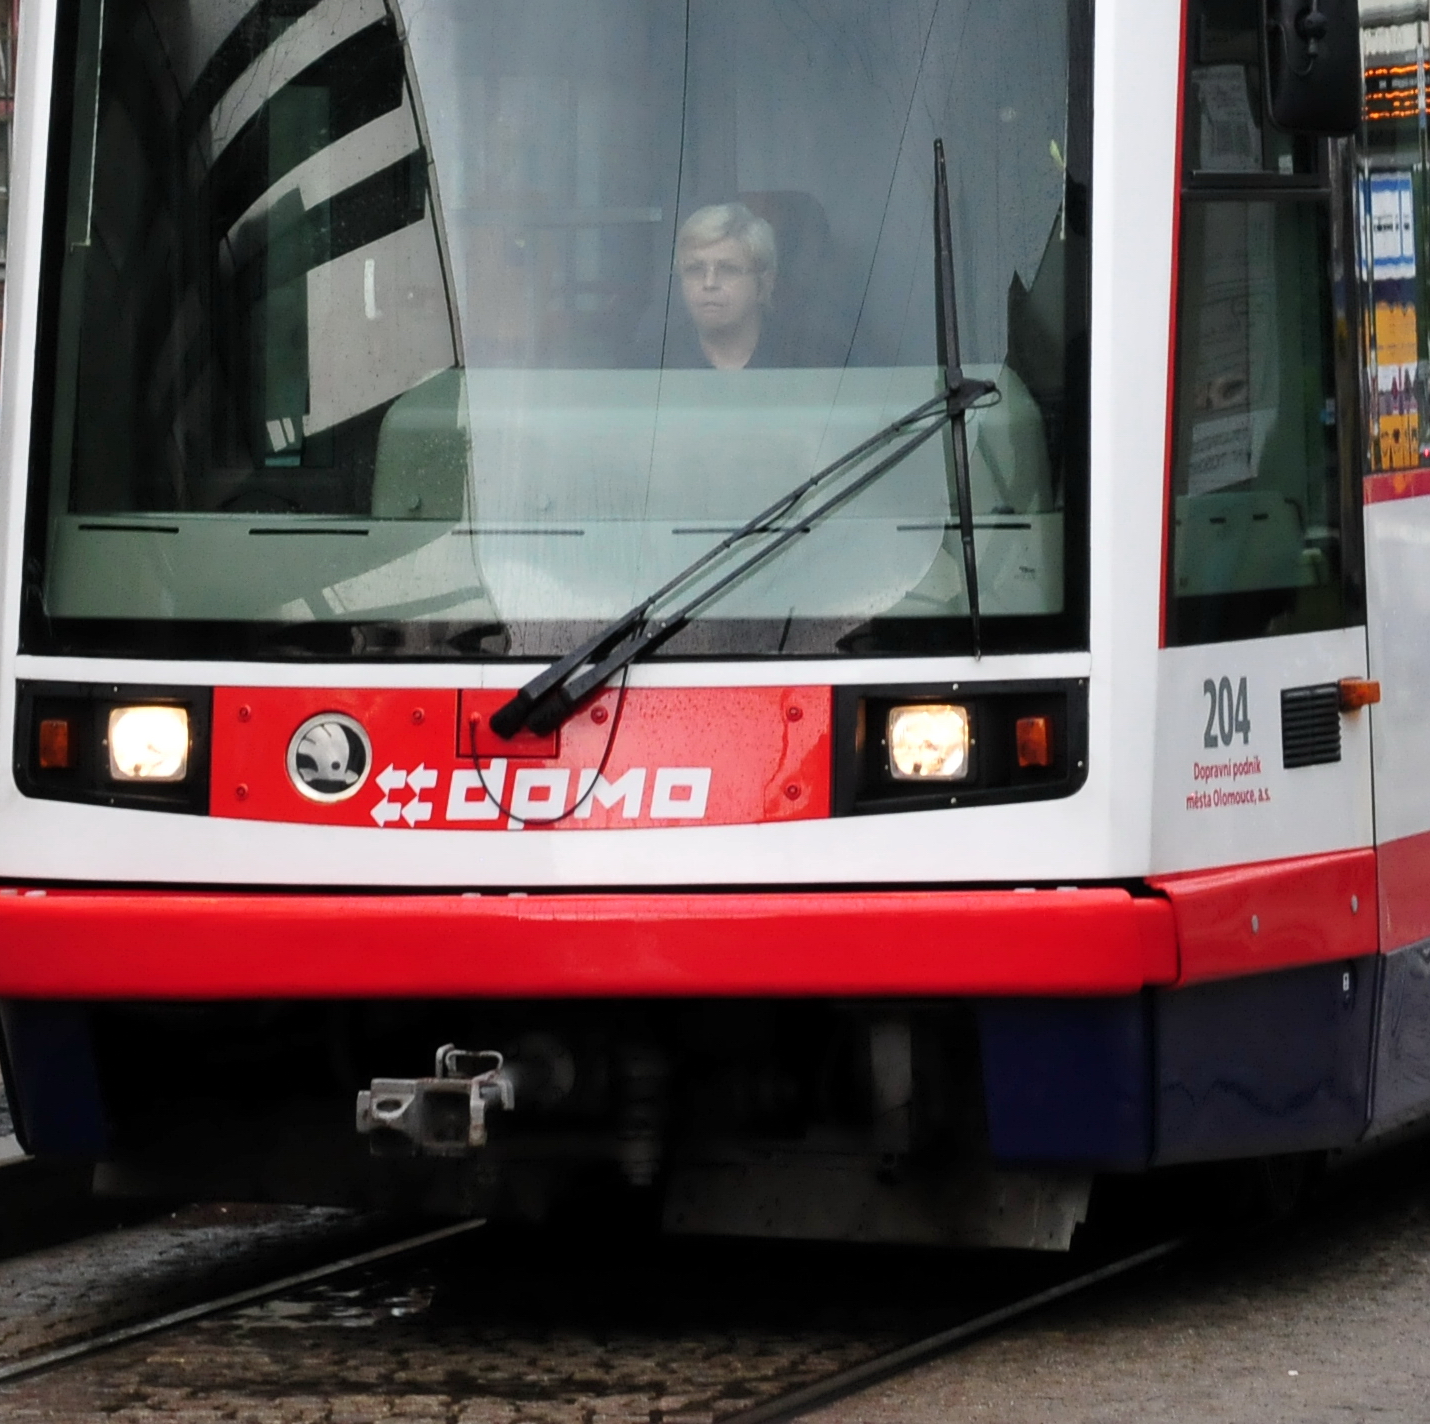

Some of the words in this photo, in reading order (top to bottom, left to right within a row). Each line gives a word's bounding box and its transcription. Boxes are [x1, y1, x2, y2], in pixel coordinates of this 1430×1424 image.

[1203, 676, 1251, 749] 204
[1193, 758, 1231, 784] Dopravní
[1232, 755, 1261, 782] podnik
[1213, 787, 1257, 806] Olomouce,
